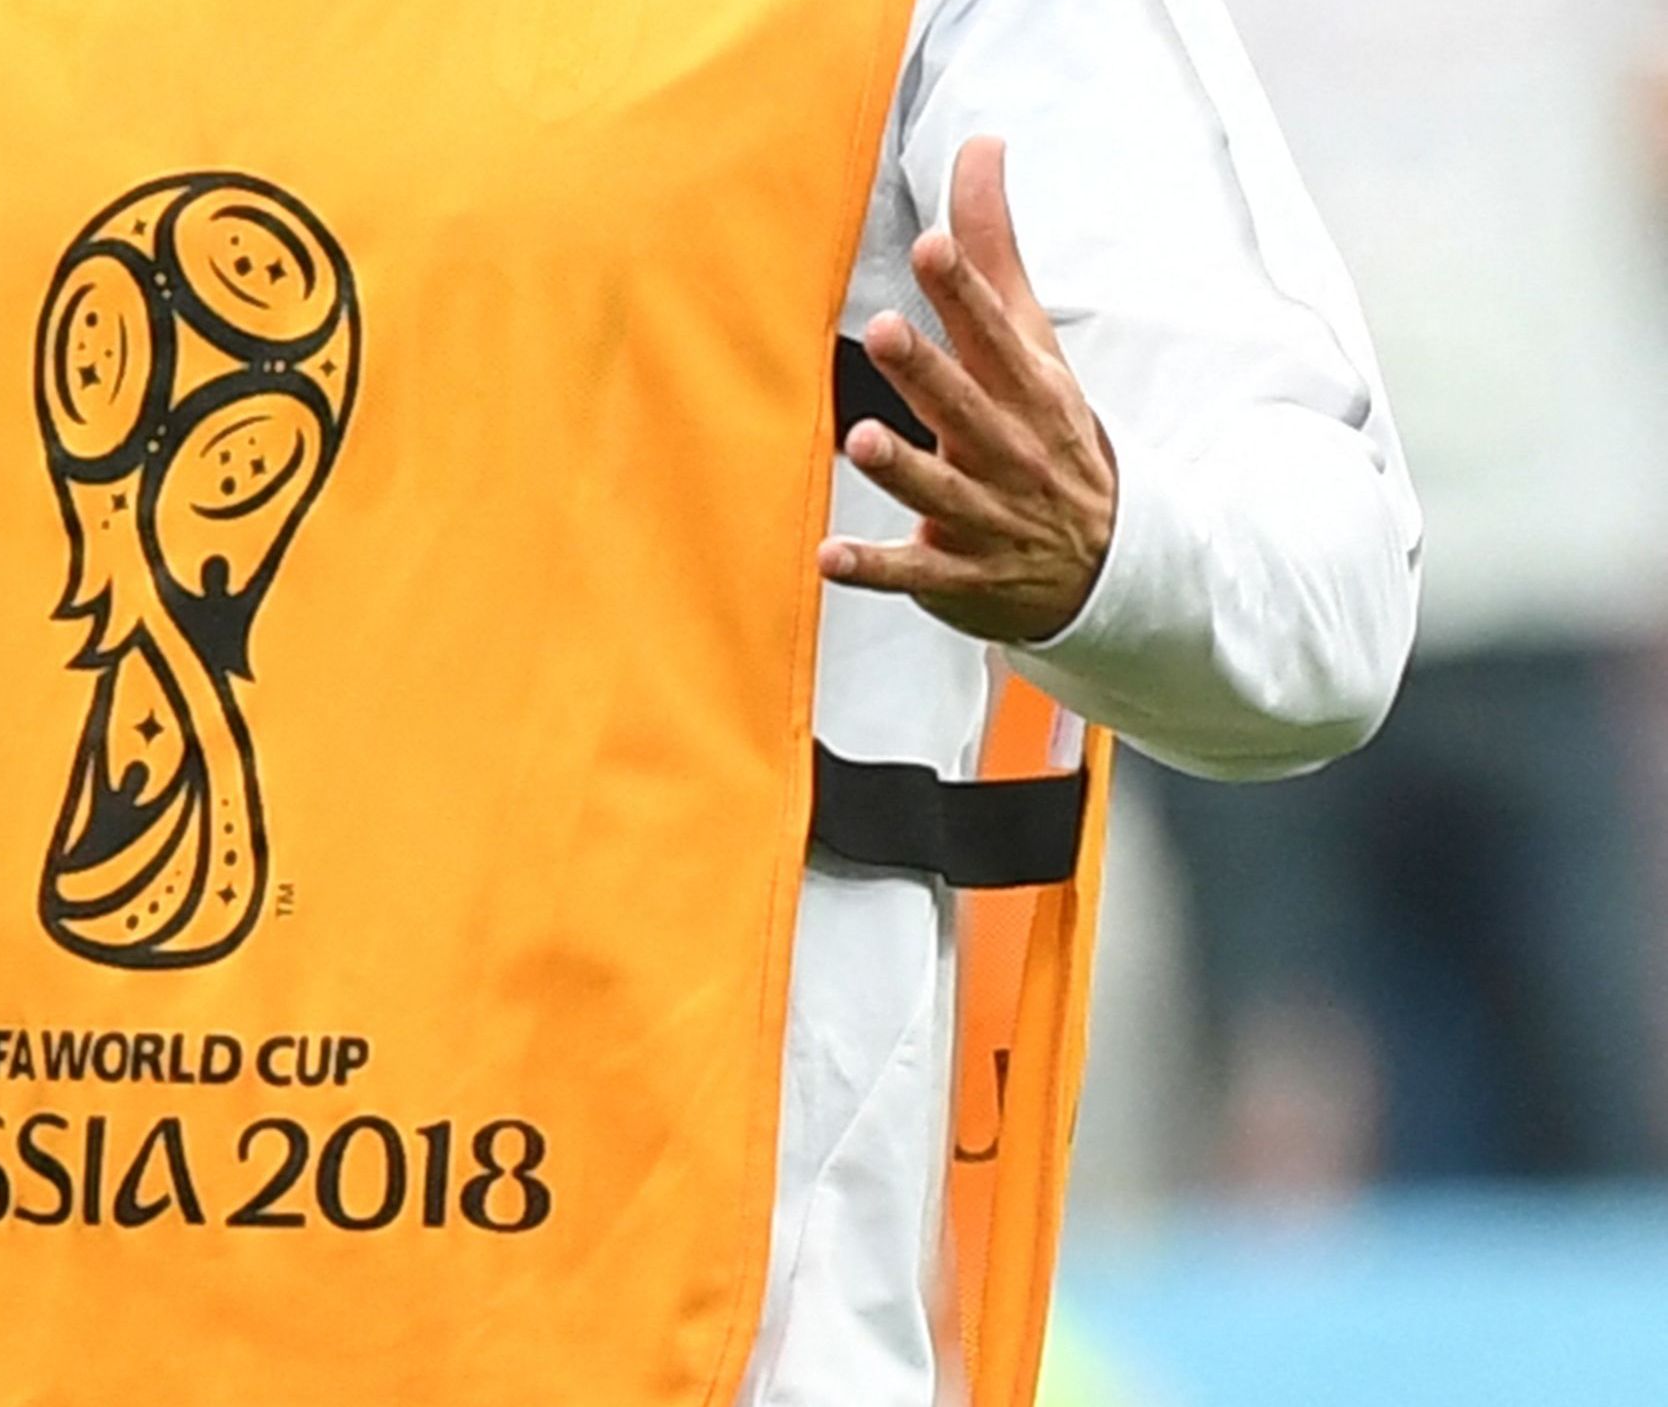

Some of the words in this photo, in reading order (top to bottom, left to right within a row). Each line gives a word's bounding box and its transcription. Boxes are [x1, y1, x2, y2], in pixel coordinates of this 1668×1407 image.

[41, 1029, 243, 1086] WORLD
[254, 1035, 370, 1087] CUP
[225, 1115, 552, 1233] 2018
